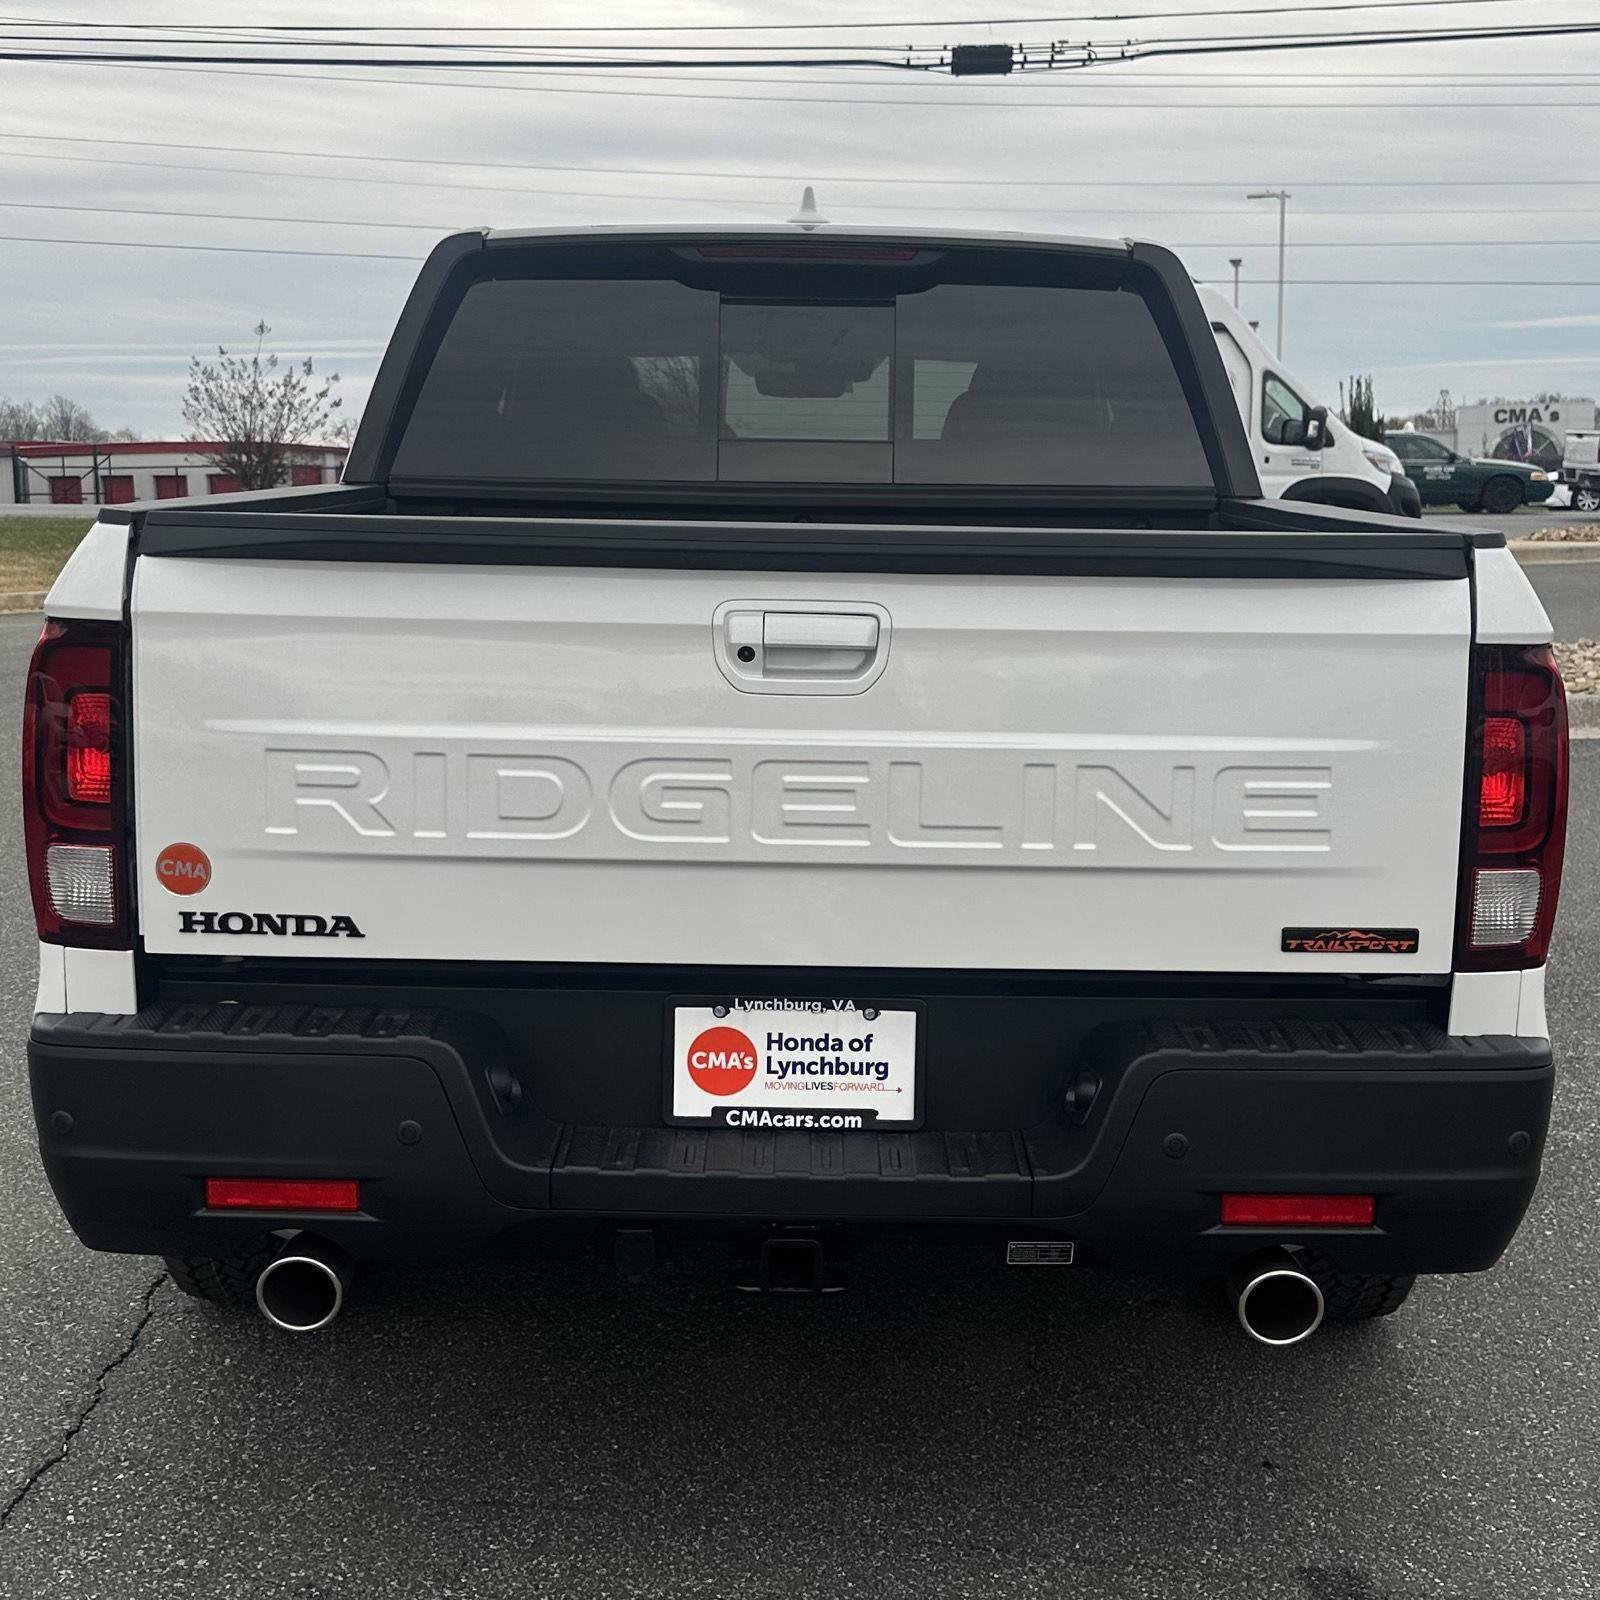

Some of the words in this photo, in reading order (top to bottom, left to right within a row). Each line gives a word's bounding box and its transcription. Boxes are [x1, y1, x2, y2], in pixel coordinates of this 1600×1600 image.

[1494, 404, 1560, 424] CMA's
[263, 746, 1333, 852] RIDGELINE
[159, 859, 207, 880] CMA
[178, 911, 366, 938] HONDA
[1286, 939, 1416, 953] TRAILSPORT
[734, 998, 827, 1014] Lynchburg,
[832, 999, 856, 1012] VA
[766, 1032, 843, 1052] Honda
[848, 1033, 873, 1052] of
[691, 1051, 755, 1070] CMA's
[766, 1055, 889, 1080] Lynchburg
[725, 1109, 862, 1129] CMAcars.com
